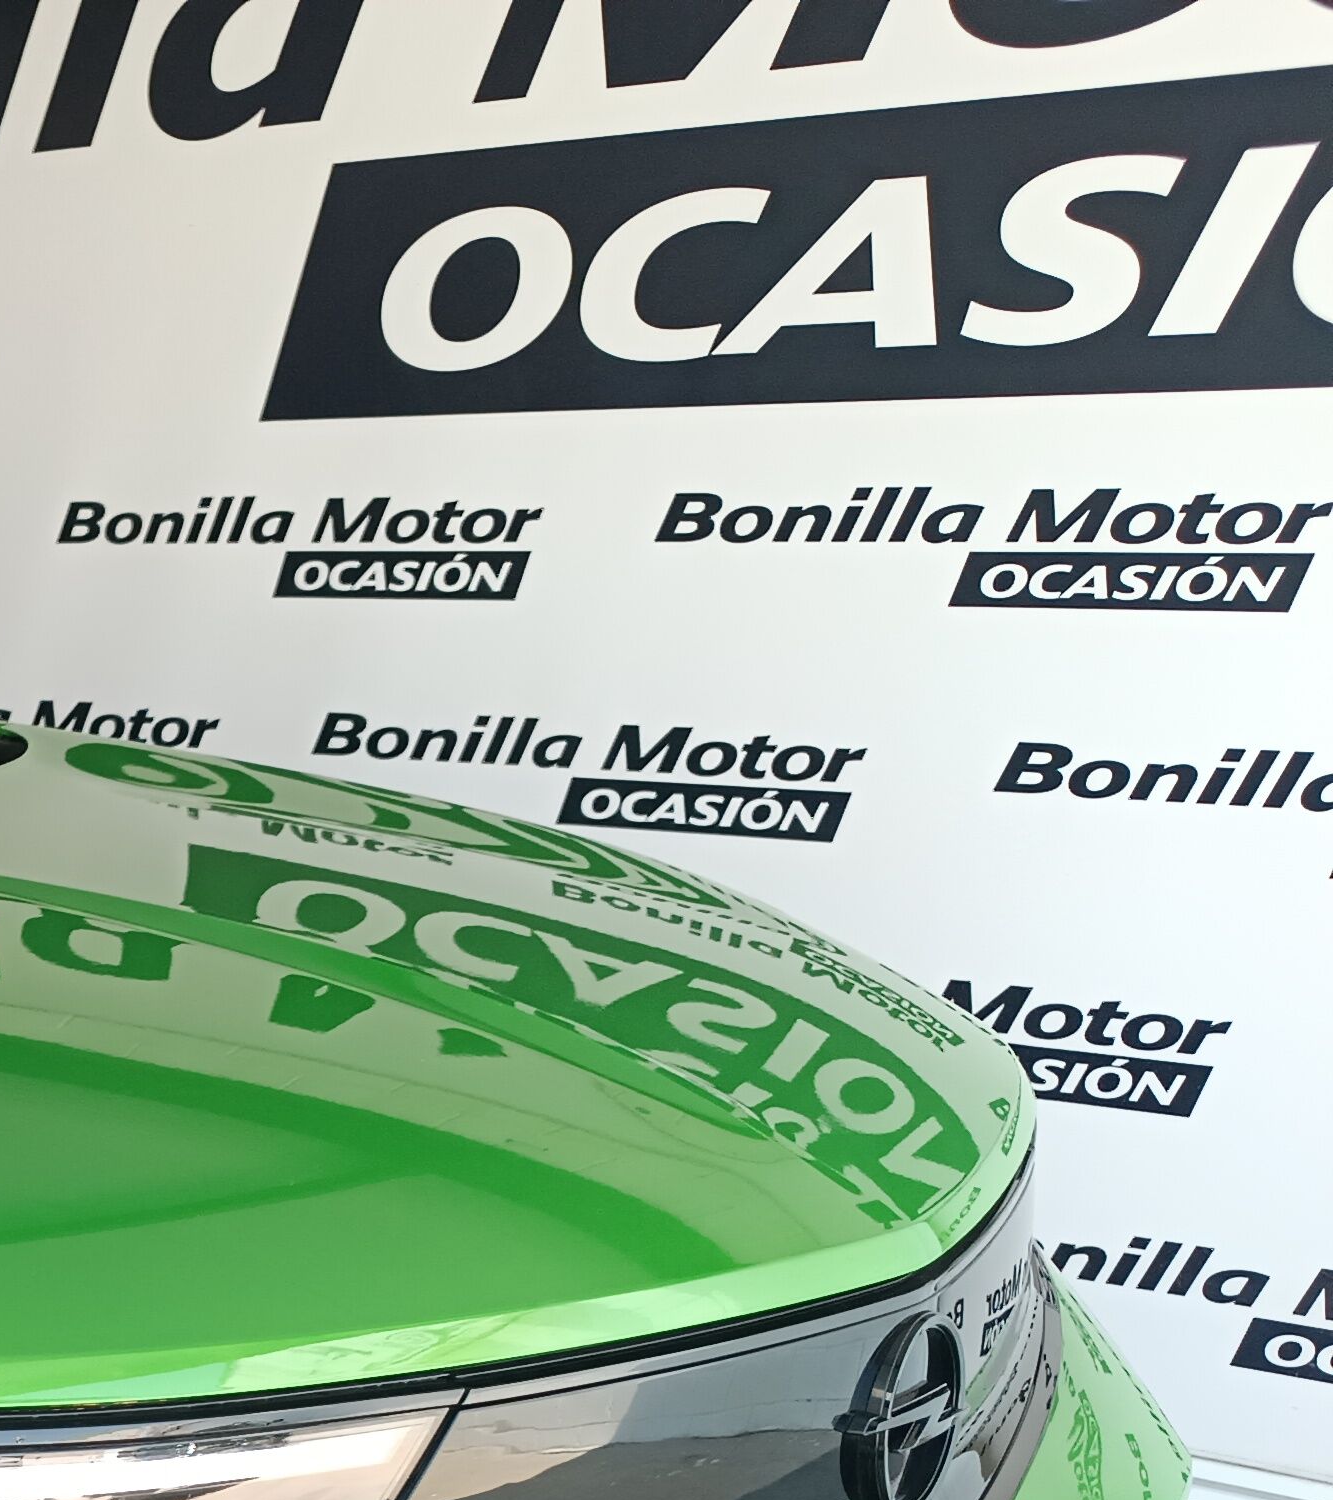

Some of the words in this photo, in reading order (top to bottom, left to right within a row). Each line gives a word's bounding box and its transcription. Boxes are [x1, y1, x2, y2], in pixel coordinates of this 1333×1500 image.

[379, 141, 1333, 373] OCASI
[56, 496, 296, 546] Bonilla
[311, 496, 545, 545] Motor
[654, 486, 985, 544] Bonilla
[1005, 487, 1333, 545] Motor
[293, 553, 513, 593] OCASIÓN
[979, 556, 1287, 604] OCASIÓN
[32, 700, 222, 749] Motor
[311, 712, 584, 768] Bonilla
[601, 724, 869, 783] Motor
[580, 789, 832, 834] OCASIÓN
[941, 979, 1233, 1055] Motor
